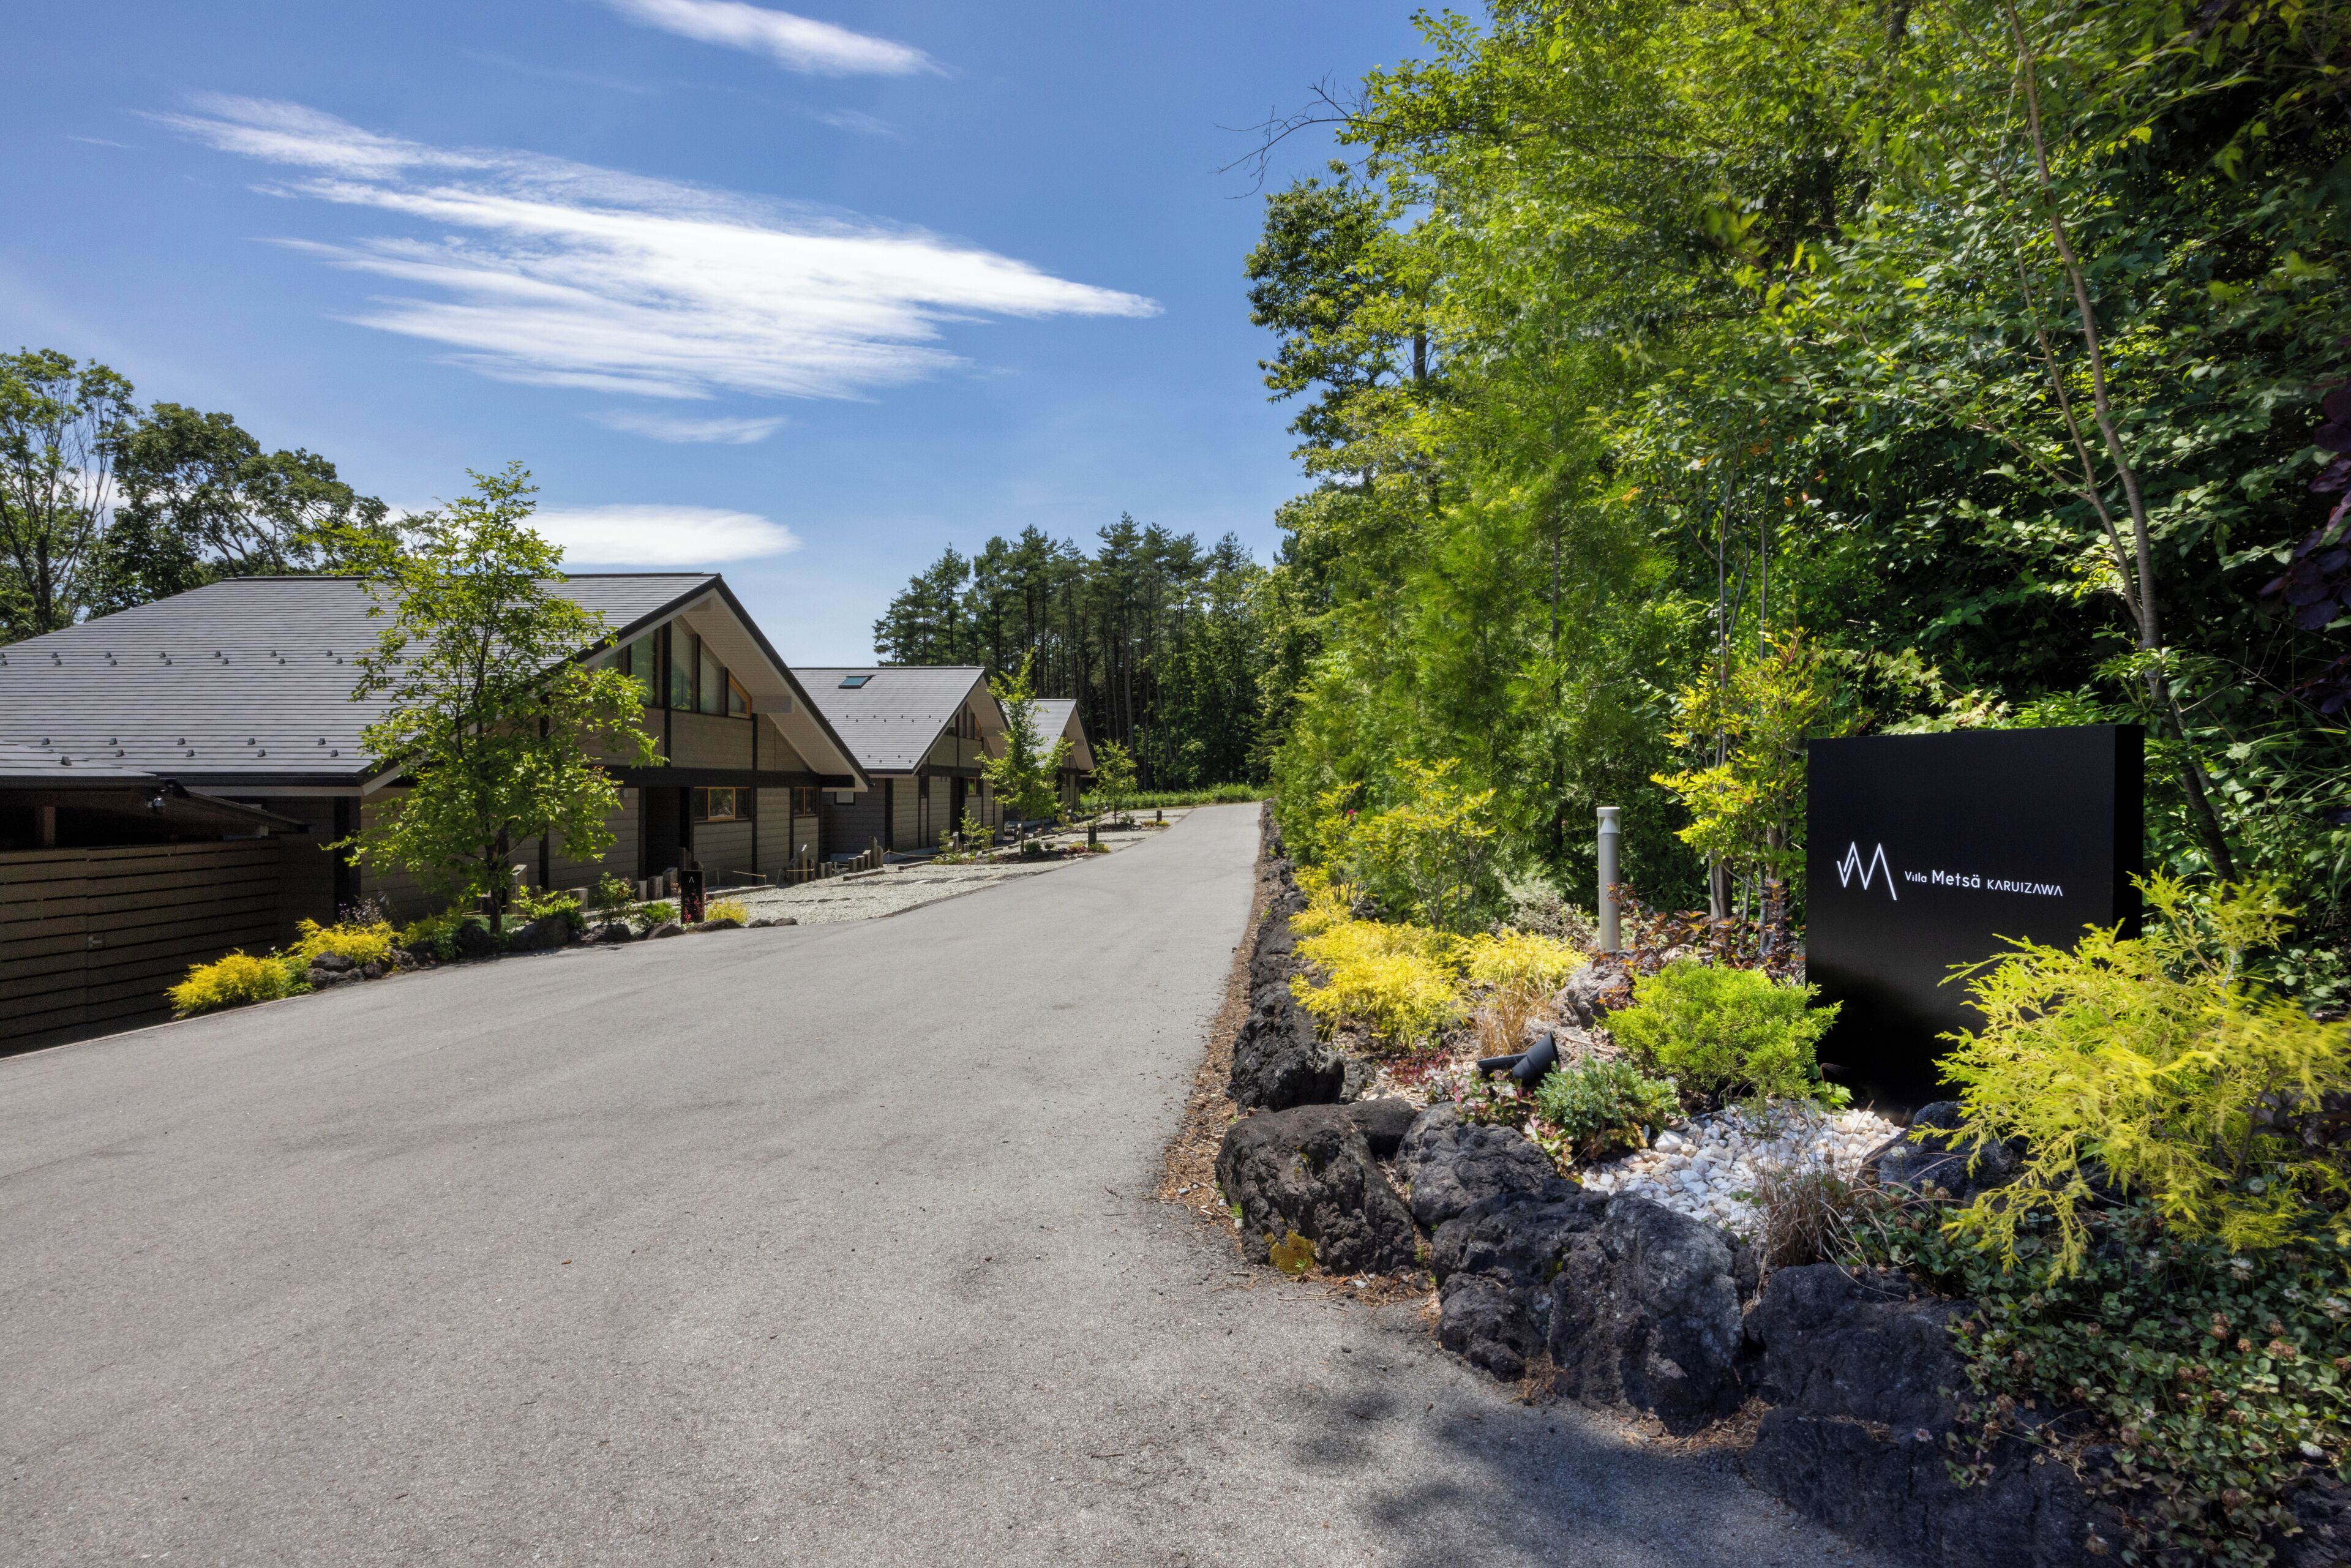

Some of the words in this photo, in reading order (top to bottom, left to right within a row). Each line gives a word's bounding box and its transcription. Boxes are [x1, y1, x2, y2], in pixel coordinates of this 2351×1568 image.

[1904, 871, 1927, 883] Villa
[1932, 869, 1981, 888] Metsä
[1987, 879, 2063, 897] KARUIZAWA
